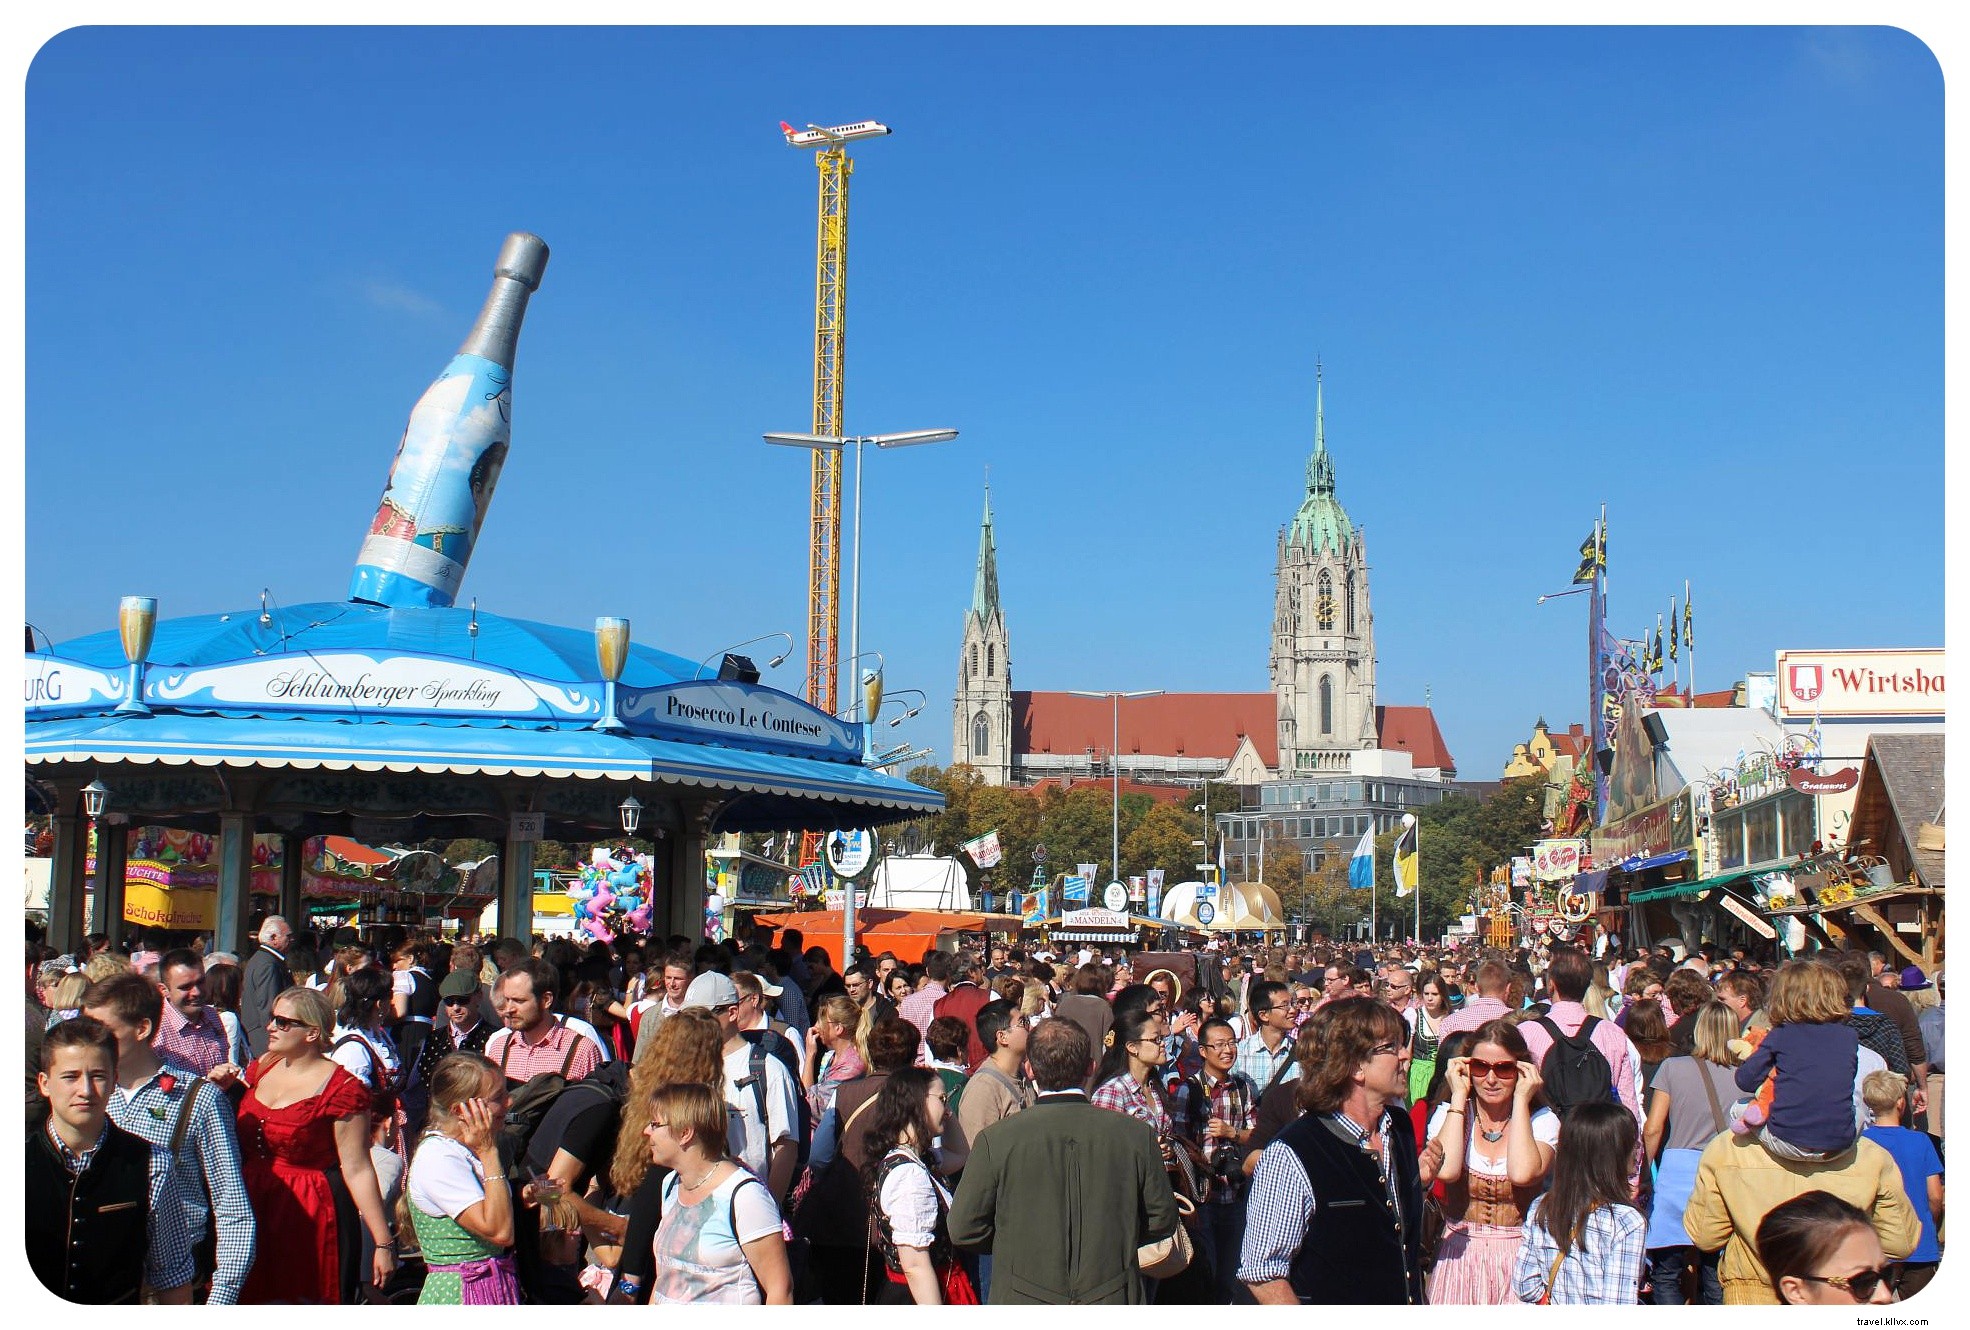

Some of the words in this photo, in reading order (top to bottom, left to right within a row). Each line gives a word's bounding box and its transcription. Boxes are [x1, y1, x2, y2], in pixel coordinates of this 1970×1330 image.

[266, 668, 418, 708] Schlumberger
[421, 679, 501, 708] Sparkling
[667, 695, 735, 725] Prosecco
[740, 707, 757, 729] Le
[762, 710, 822, 738] Contesse
[1798, 781, 1848, 791] Bratwurst
[1074, 916, 1117, 925] MANDELN
[1723, 898, 1773, 938] Schnellfeuer
